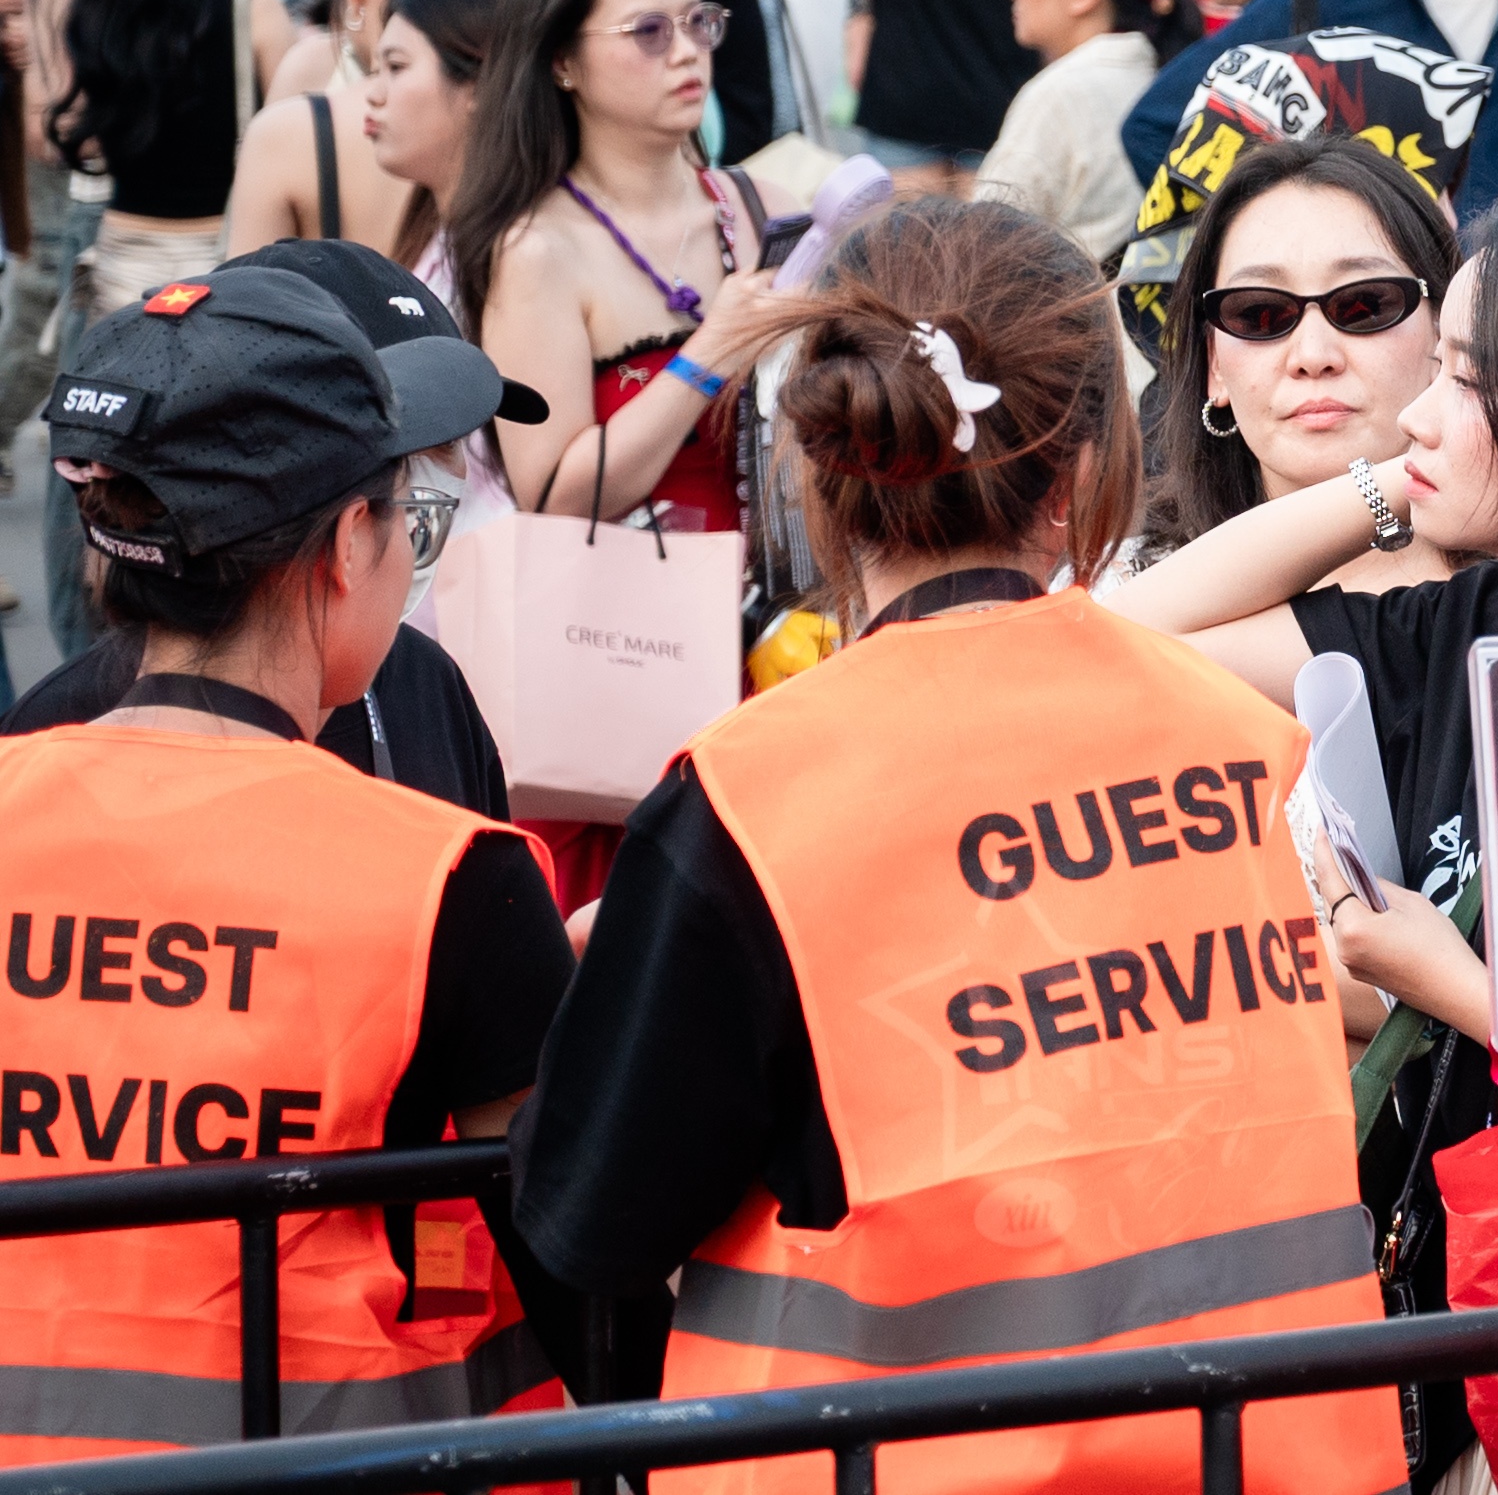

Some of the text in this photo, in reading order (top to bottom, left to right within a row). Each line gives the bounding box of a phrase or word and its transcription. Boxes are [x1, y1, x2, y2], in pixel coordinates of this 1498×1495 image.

[62, 385, 128, 418] STAFF
[956, 759, 1270, 903] GUEST
[4, 910, 279, 1014] UEST
[944, 915, 1328, 1074] SERVICE
[0, 1068, 322, 1165] RVICE
